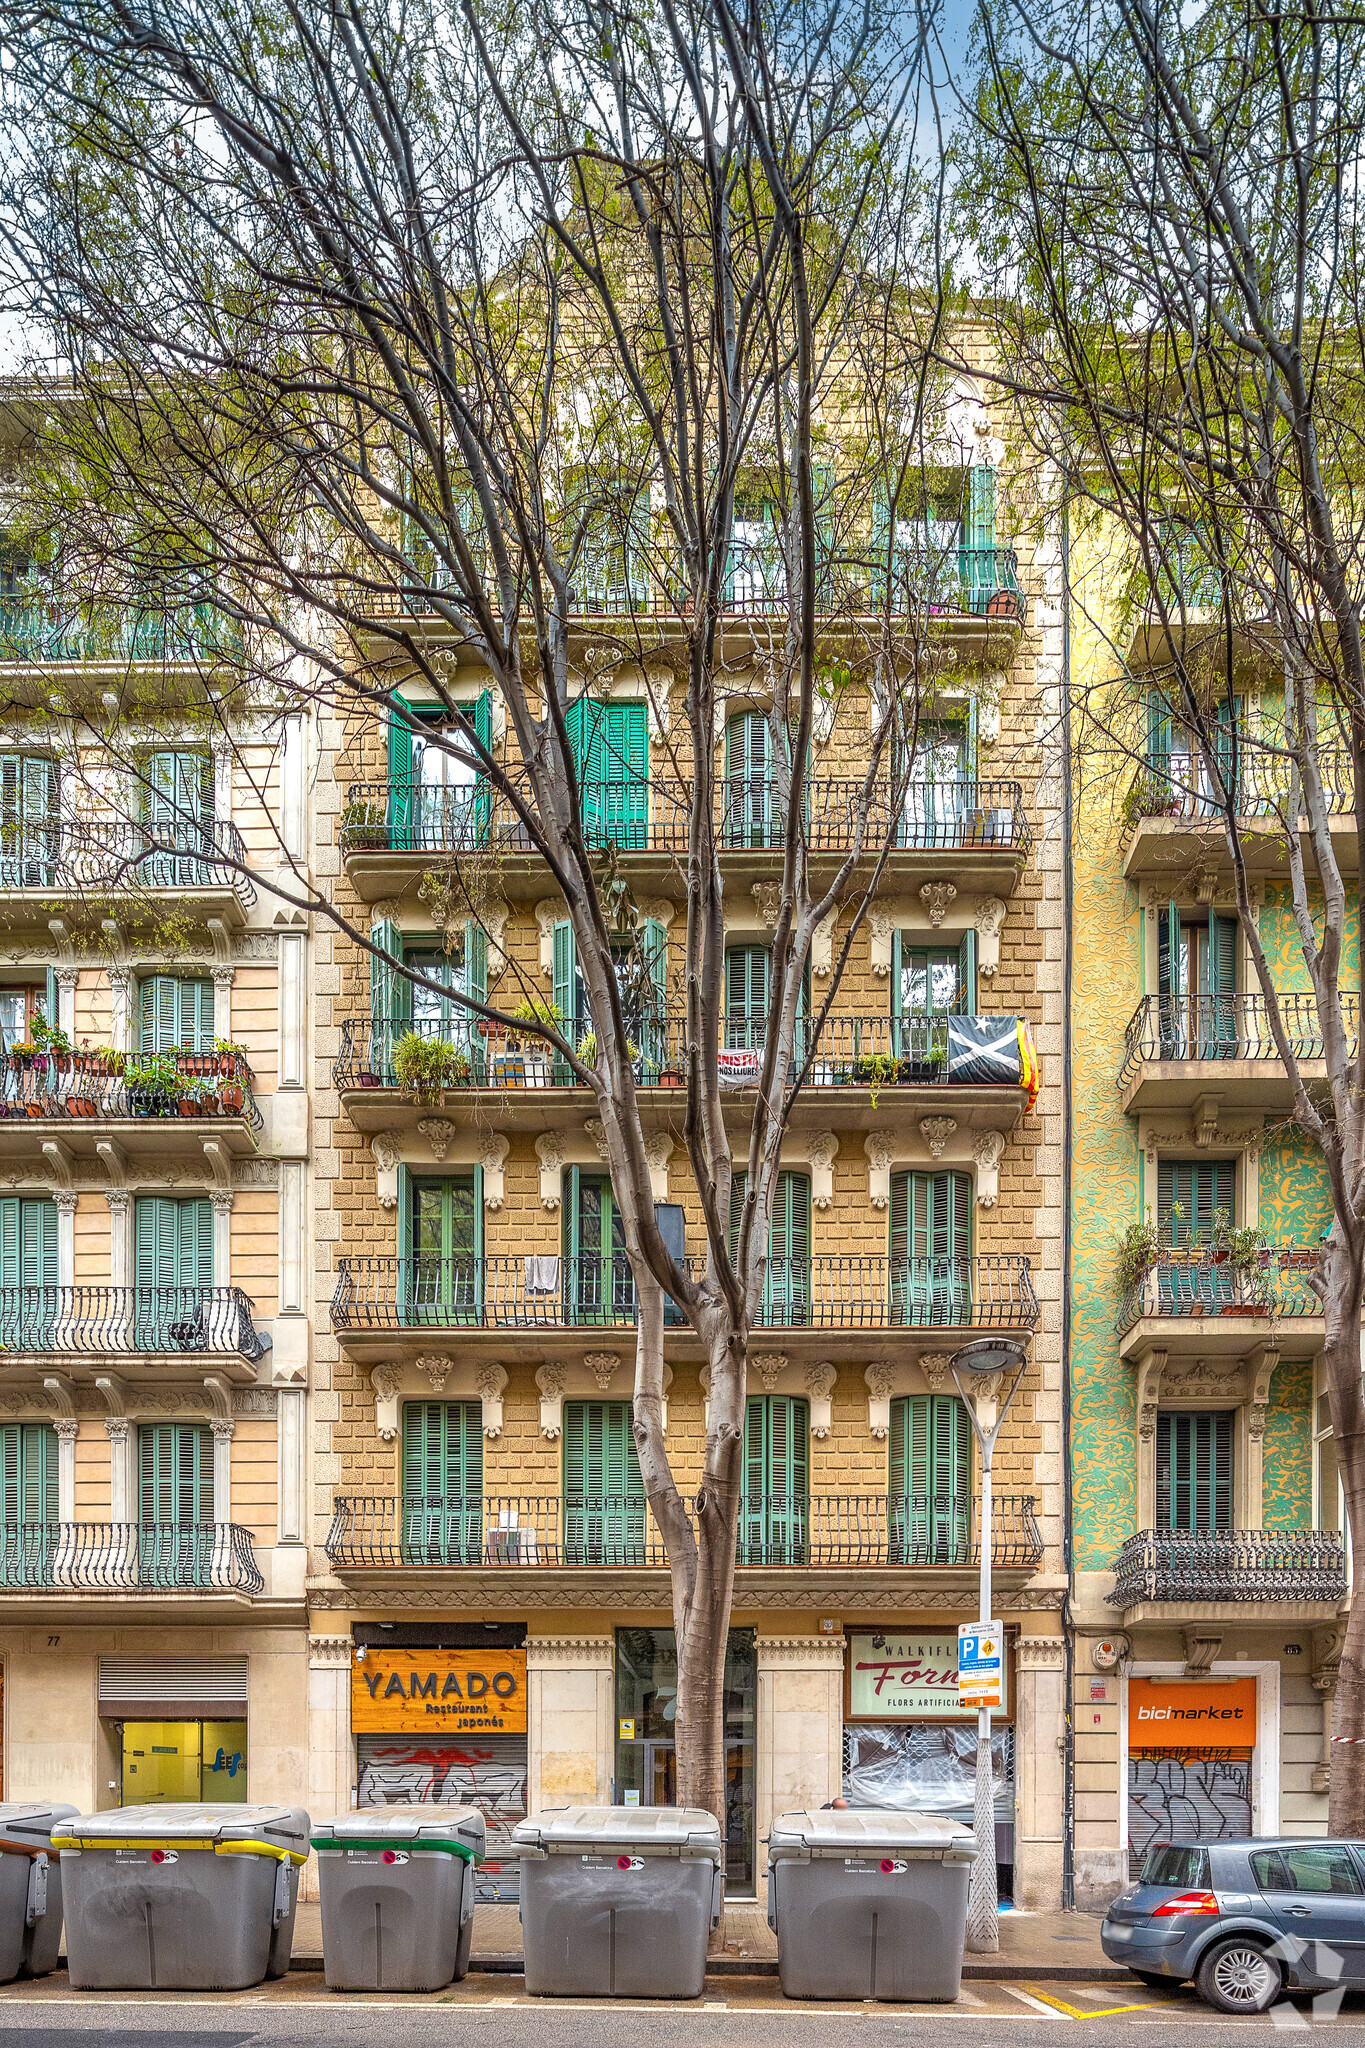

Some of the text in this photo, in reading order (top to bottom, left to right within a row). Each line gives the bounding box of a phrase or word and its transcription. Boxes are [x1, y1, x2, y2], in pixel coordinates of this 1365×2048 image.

[717, 1054, 759, 1066] NISTIA
[48, 1636, 60, 1646] 77
[885, 1646, 959, 1656] WALKIFL
[963, 1639, 974, 1658] P
[363, 1672, 515, 1697] YAMADO
[426, 1703, 487, 1714] Restaurant
[888, 1699, 913, 1707] FLORS
[918, 1698, 959, 1707] ARTIFICIA
[1138, 1706, 1243, 1720] bicimarket
[457, 1716, 503, 1728] japonés
